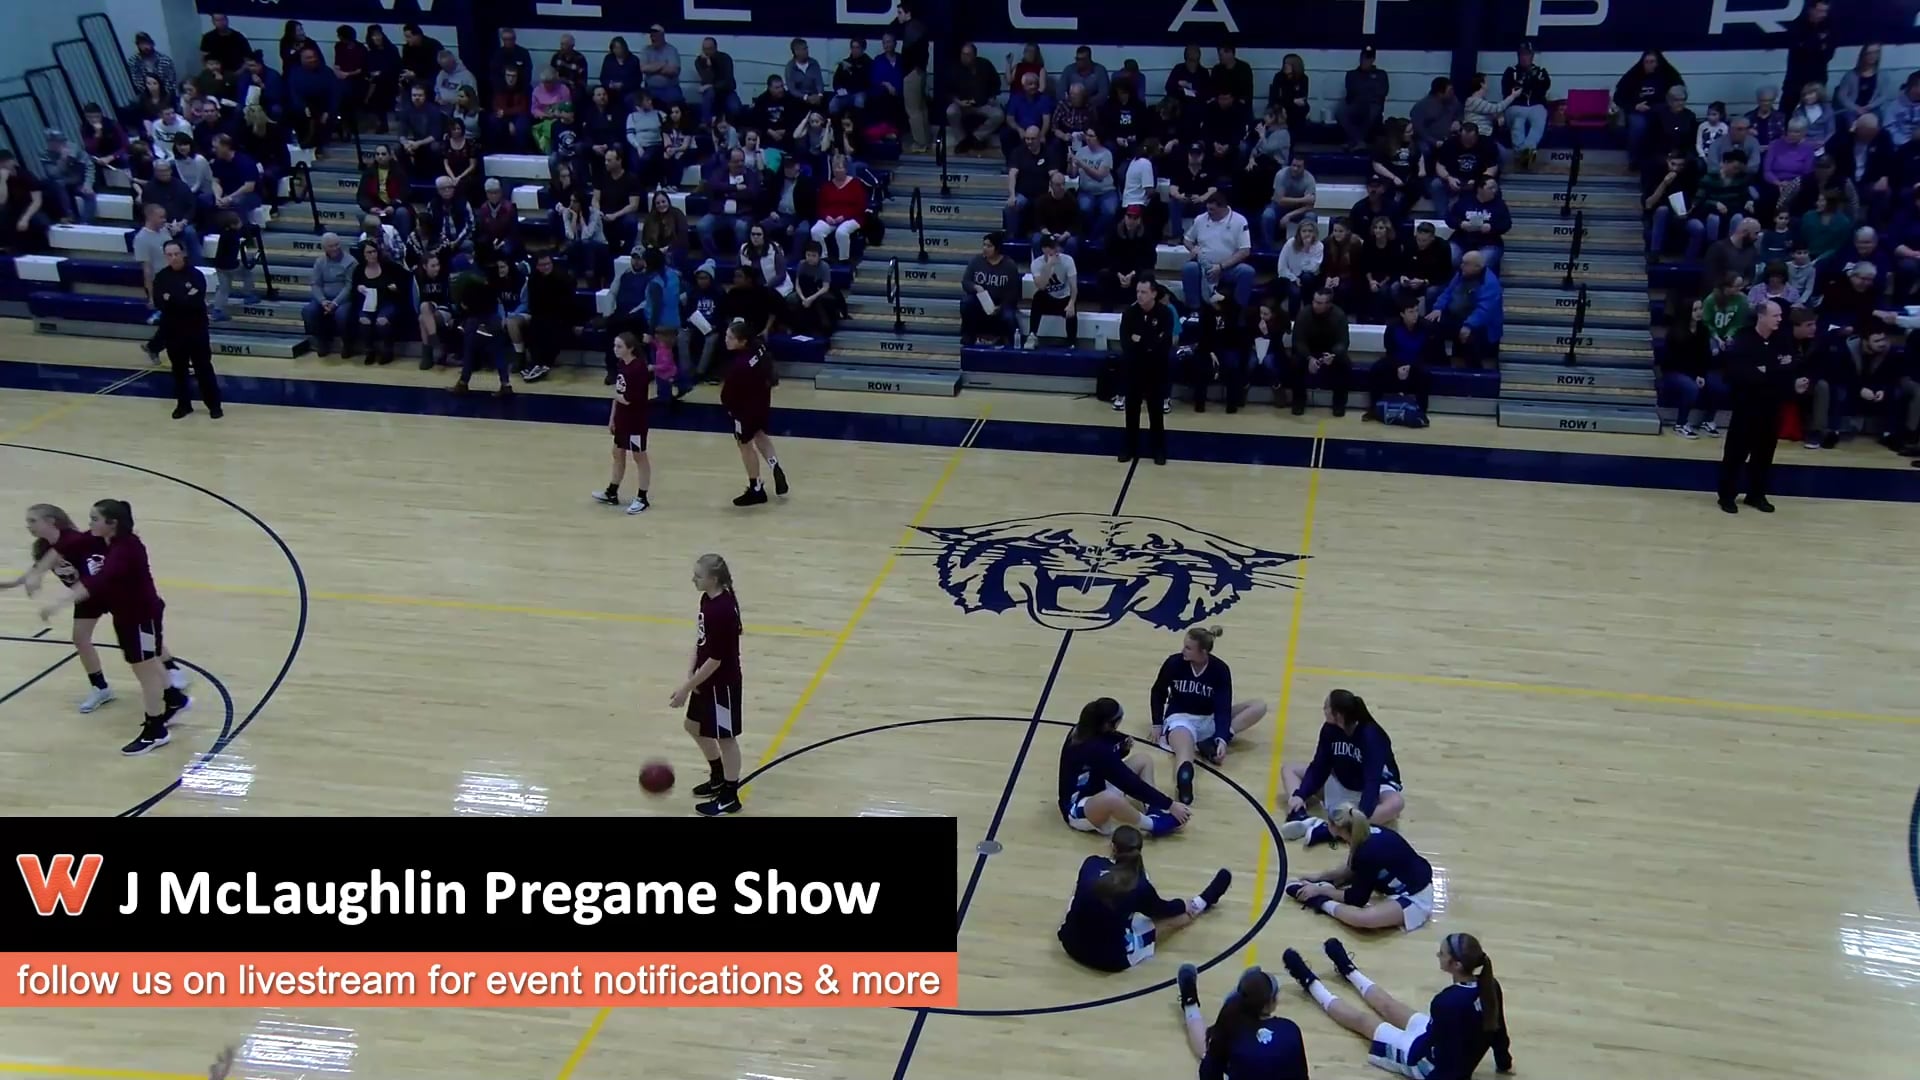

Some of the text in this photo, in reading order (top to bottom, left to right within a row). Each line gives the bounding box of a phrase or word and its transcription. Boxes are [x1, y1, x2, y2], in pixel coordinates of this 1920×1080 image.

[963, 175, 969, 183] 7
[1552, 193, 1588, 202] ROW 7
[930, 205, 960, 214] ROW 6
[339, 211, 345, 219] 5
[293, 242, 313, 250] ROW
[918, 238, 949, 247] OW 5
[1553, 262, 1589, 271] ROW 5
[905, 270, 936, 280] ROW 4
[244, 307, 274, 317] ROW 2
[1556, 336, 1593, 346] ROW 3
[221, 345, 251, 354] ROW 1
[880, 342, 913, 351] ROW 2
[1557, 375, 1595, 385] ROW 2
[867, 382, 900, 392] ROW 1
[1559, 419, 1597, 430] ROW 1
